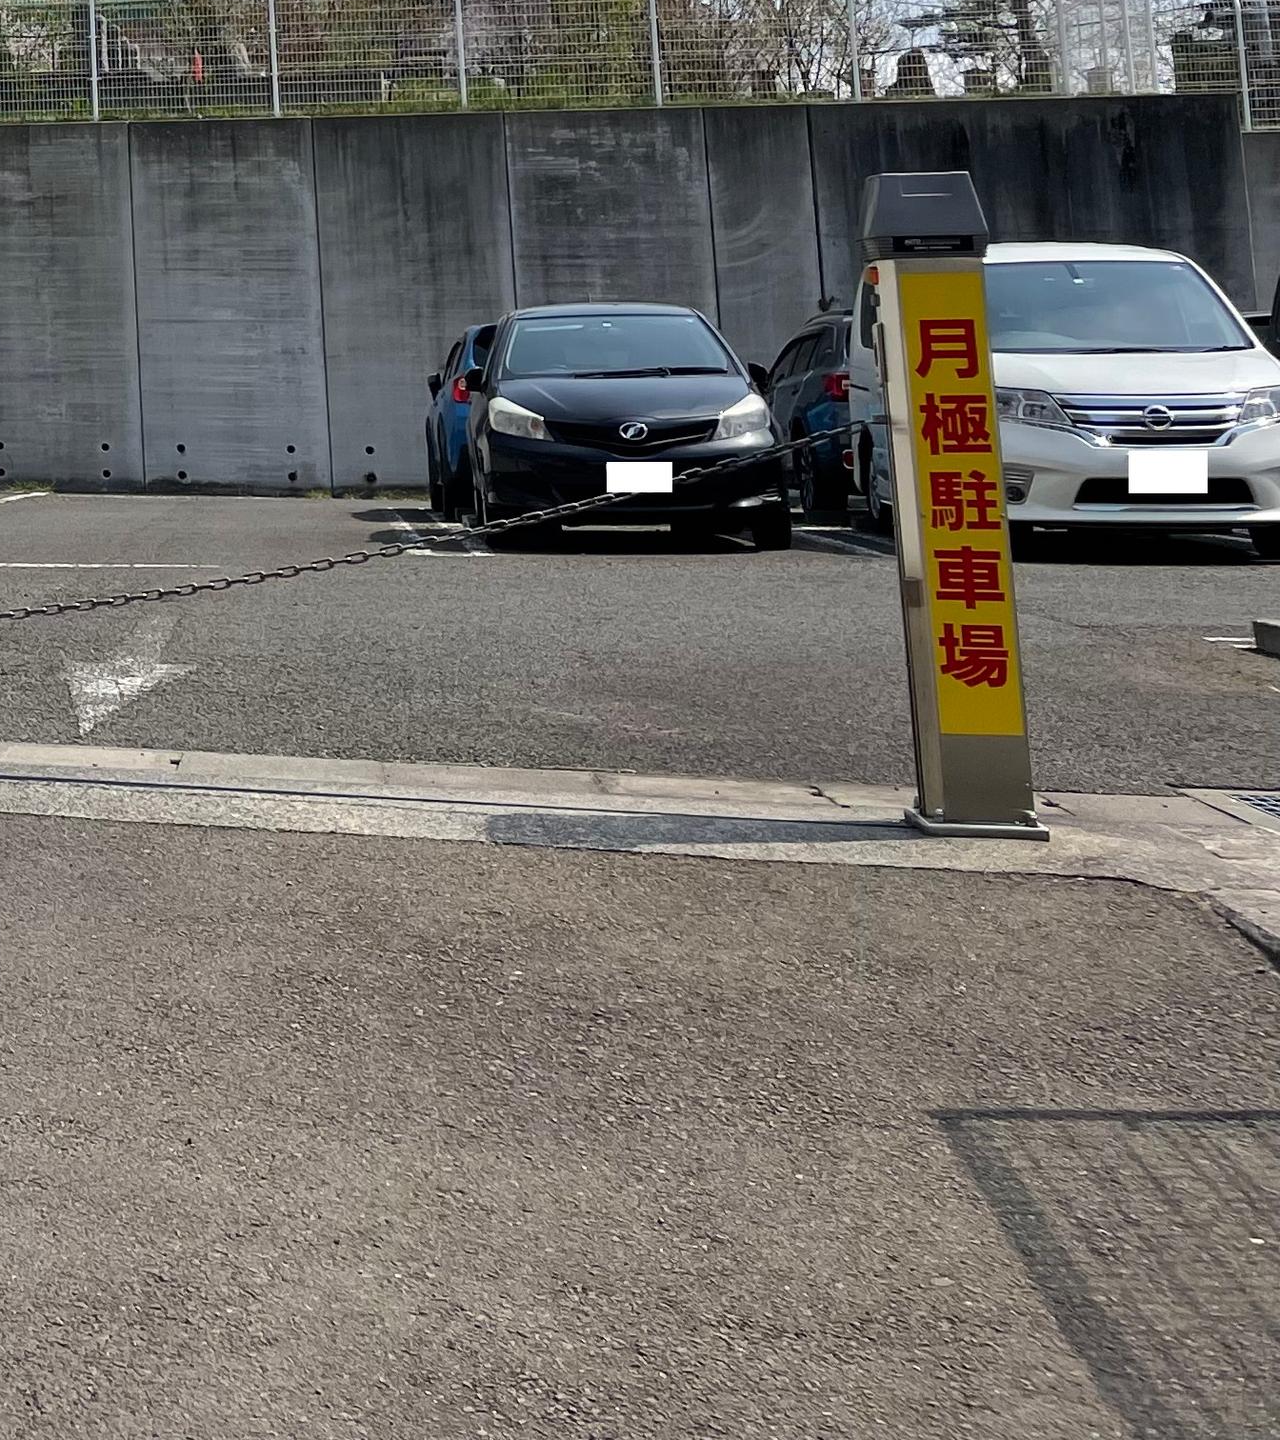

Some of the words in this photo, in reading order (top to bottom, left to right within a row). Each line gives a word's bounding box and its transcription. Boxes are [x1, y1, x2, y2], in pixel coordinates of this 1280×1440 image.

[915, 318, 1009, 689] 月極駐車場
